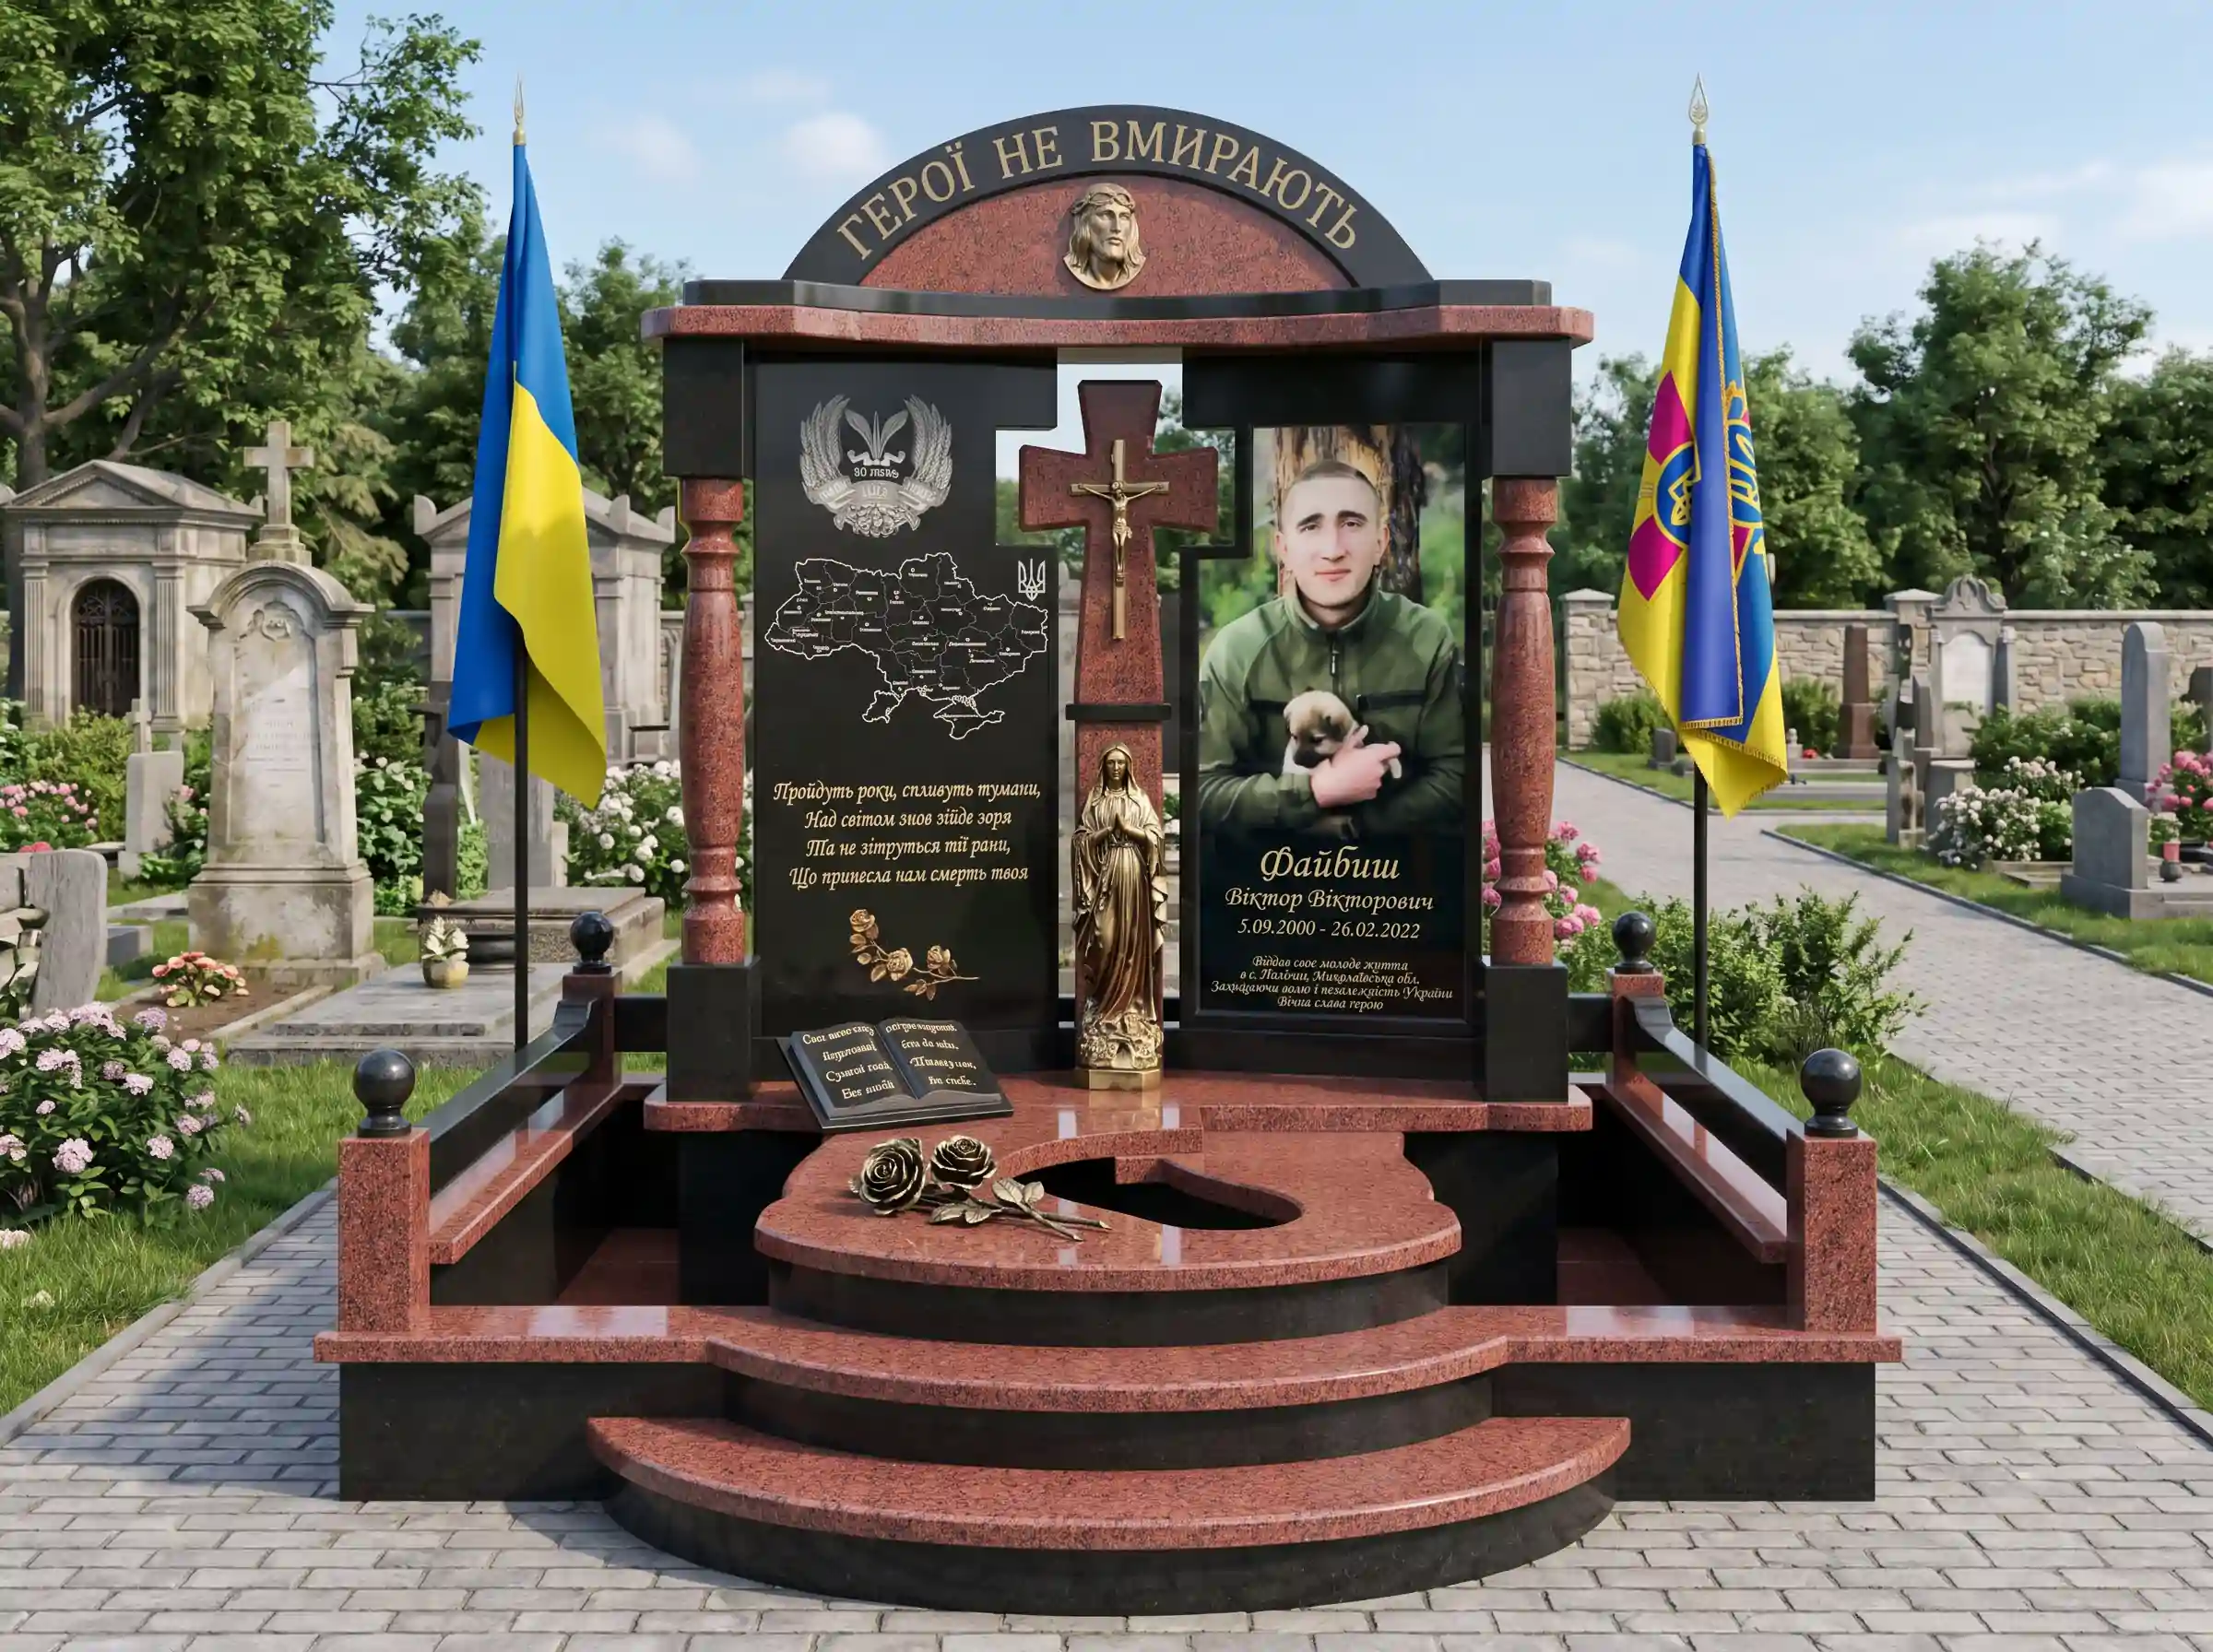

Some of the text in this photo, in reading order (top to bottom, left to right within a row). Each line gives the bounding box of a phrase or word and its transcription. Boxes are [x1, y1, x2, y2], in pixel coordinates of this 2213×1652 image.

[836, 120, 1358, 261] ГЕРОЇ НЕ ВМИРАЮТЬ
[773, 780, 1041, 806] Пройдуть роки, спливуть тумани,
[804, 806, 1012, 831] Над світом знов зійде зоря
[805, 835, 1011, 861] Та не зітруться тії рани,
[1260, 845, 1401, 882] Файбиш
[788, 867, 1029, 891] Що принесла нам смерть твоя
[1225, 887, 1435, 915] Віктор Вікторович
[1237, 918, 1316, 936] 5.09.2000
[1331, 921, 1421, 939] 26.02.2022
